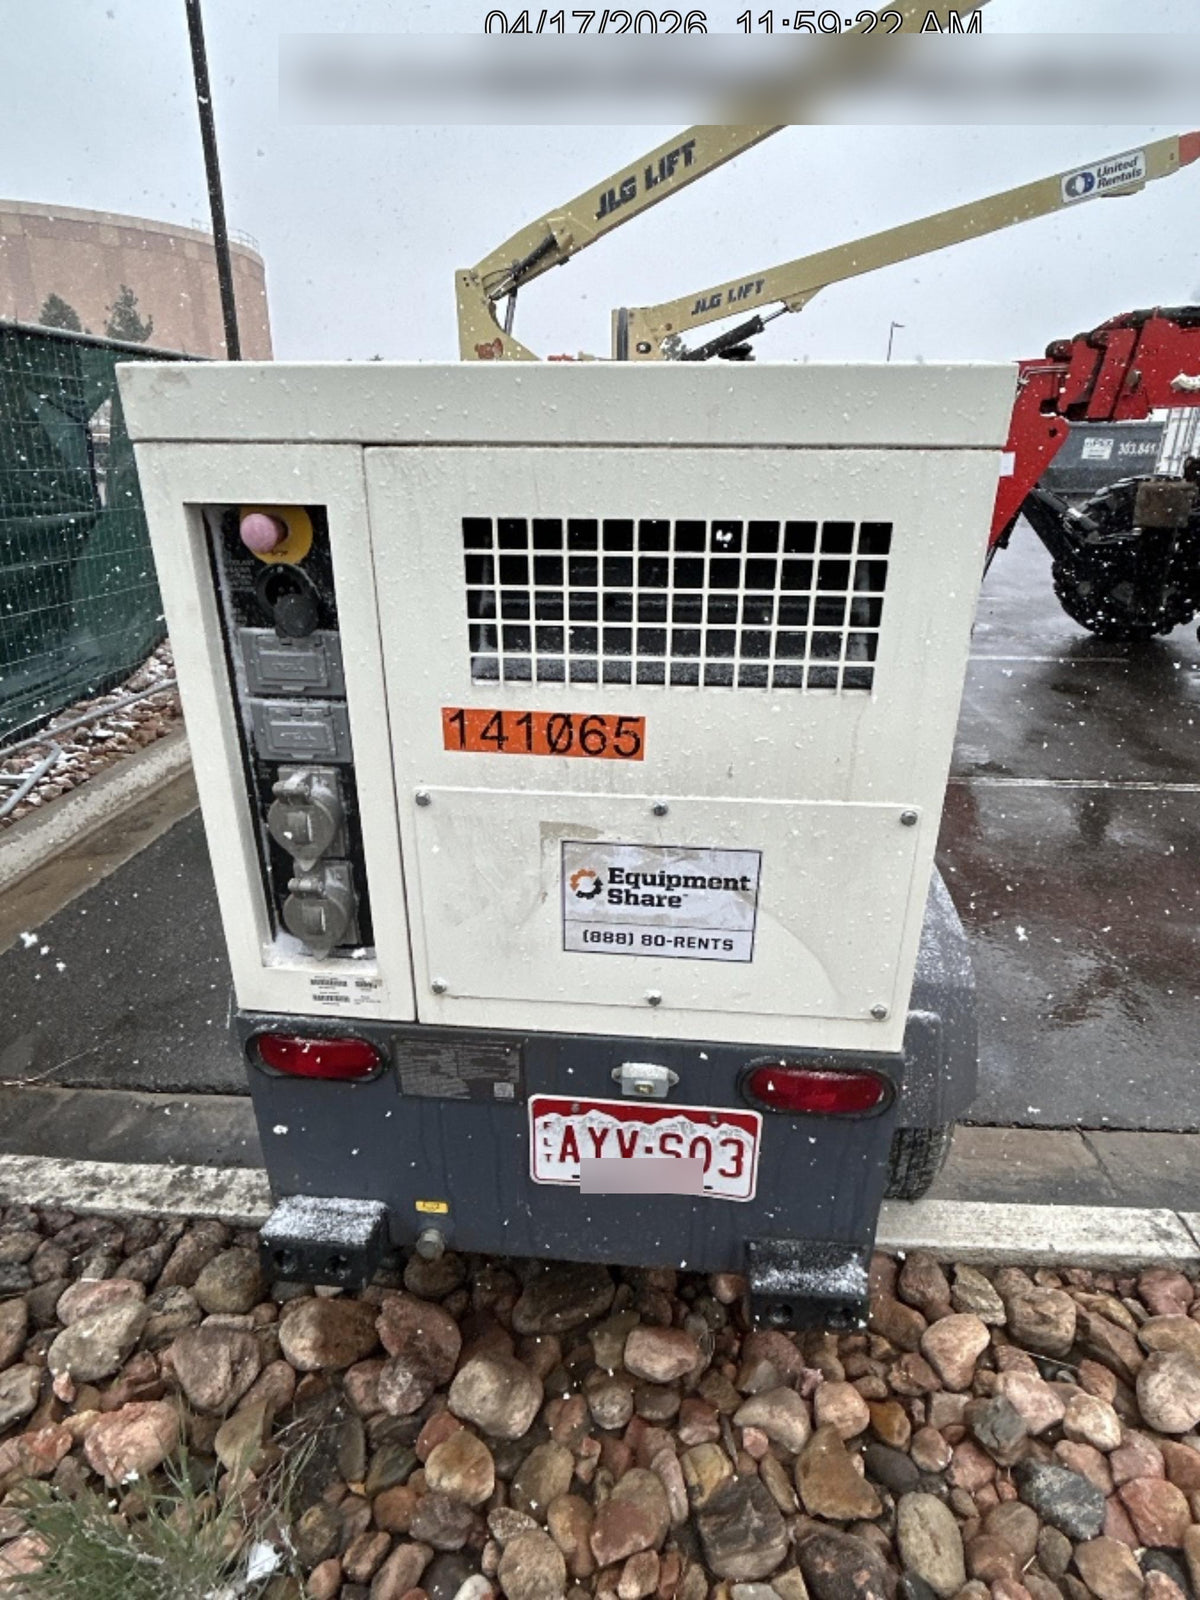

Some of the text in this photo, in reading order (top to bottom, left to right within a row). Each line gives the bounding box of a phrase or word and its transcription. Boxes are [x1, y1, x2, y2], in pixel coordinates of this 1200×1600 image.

[1096, 156, 1139, 178] United
[1097, 167, 1142, 189] Rentals
[595, 138, 696, 220] JLG LIFT
[691, 278, 766, 315] JLG LIFT
[449, 709, 642, 757] 141065
[607, 867, 751, 892] Equipment
[607, 888, 683, 908] Share
[582, 929, 734, 951] (888) 80-RENTS
